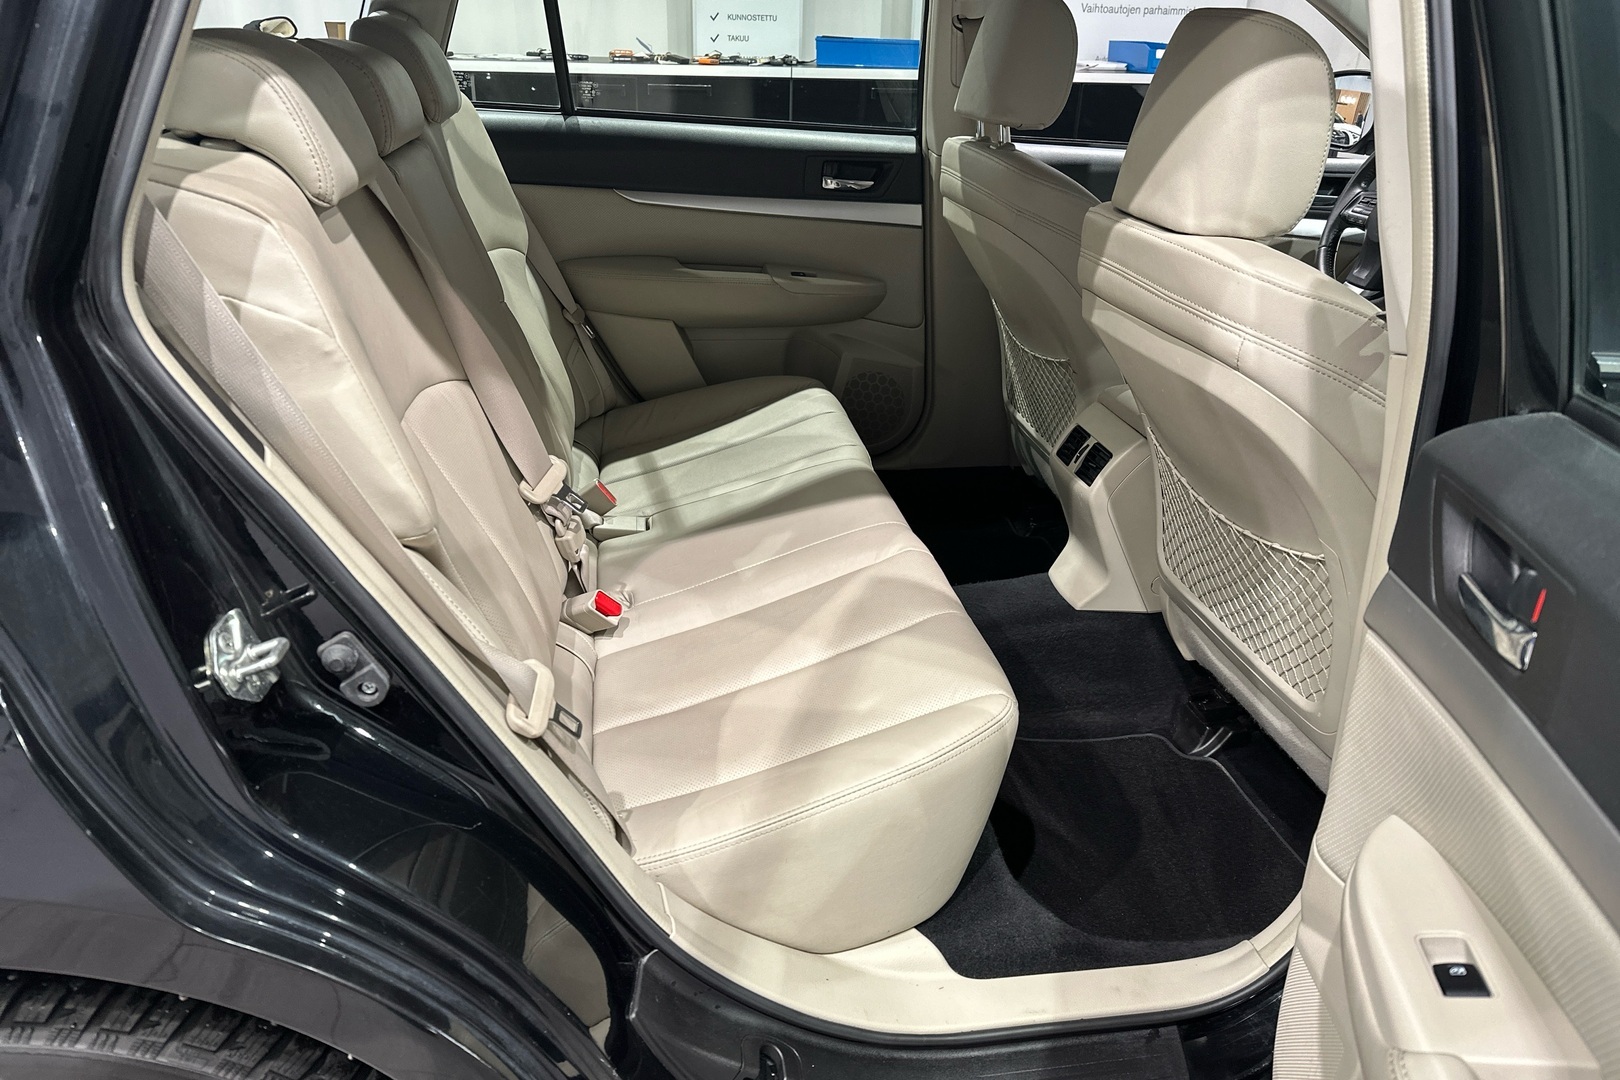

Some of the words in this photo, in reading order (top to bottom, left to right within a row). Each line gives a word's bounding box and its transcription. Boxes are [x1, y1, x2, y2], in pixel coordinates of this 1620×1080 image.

[1081, 3, 1141, 17] Vaihtoautojen
[727, 14, 778, 22] KUNNOSTETTU
[727, 34, 750, 42] TAKUU
